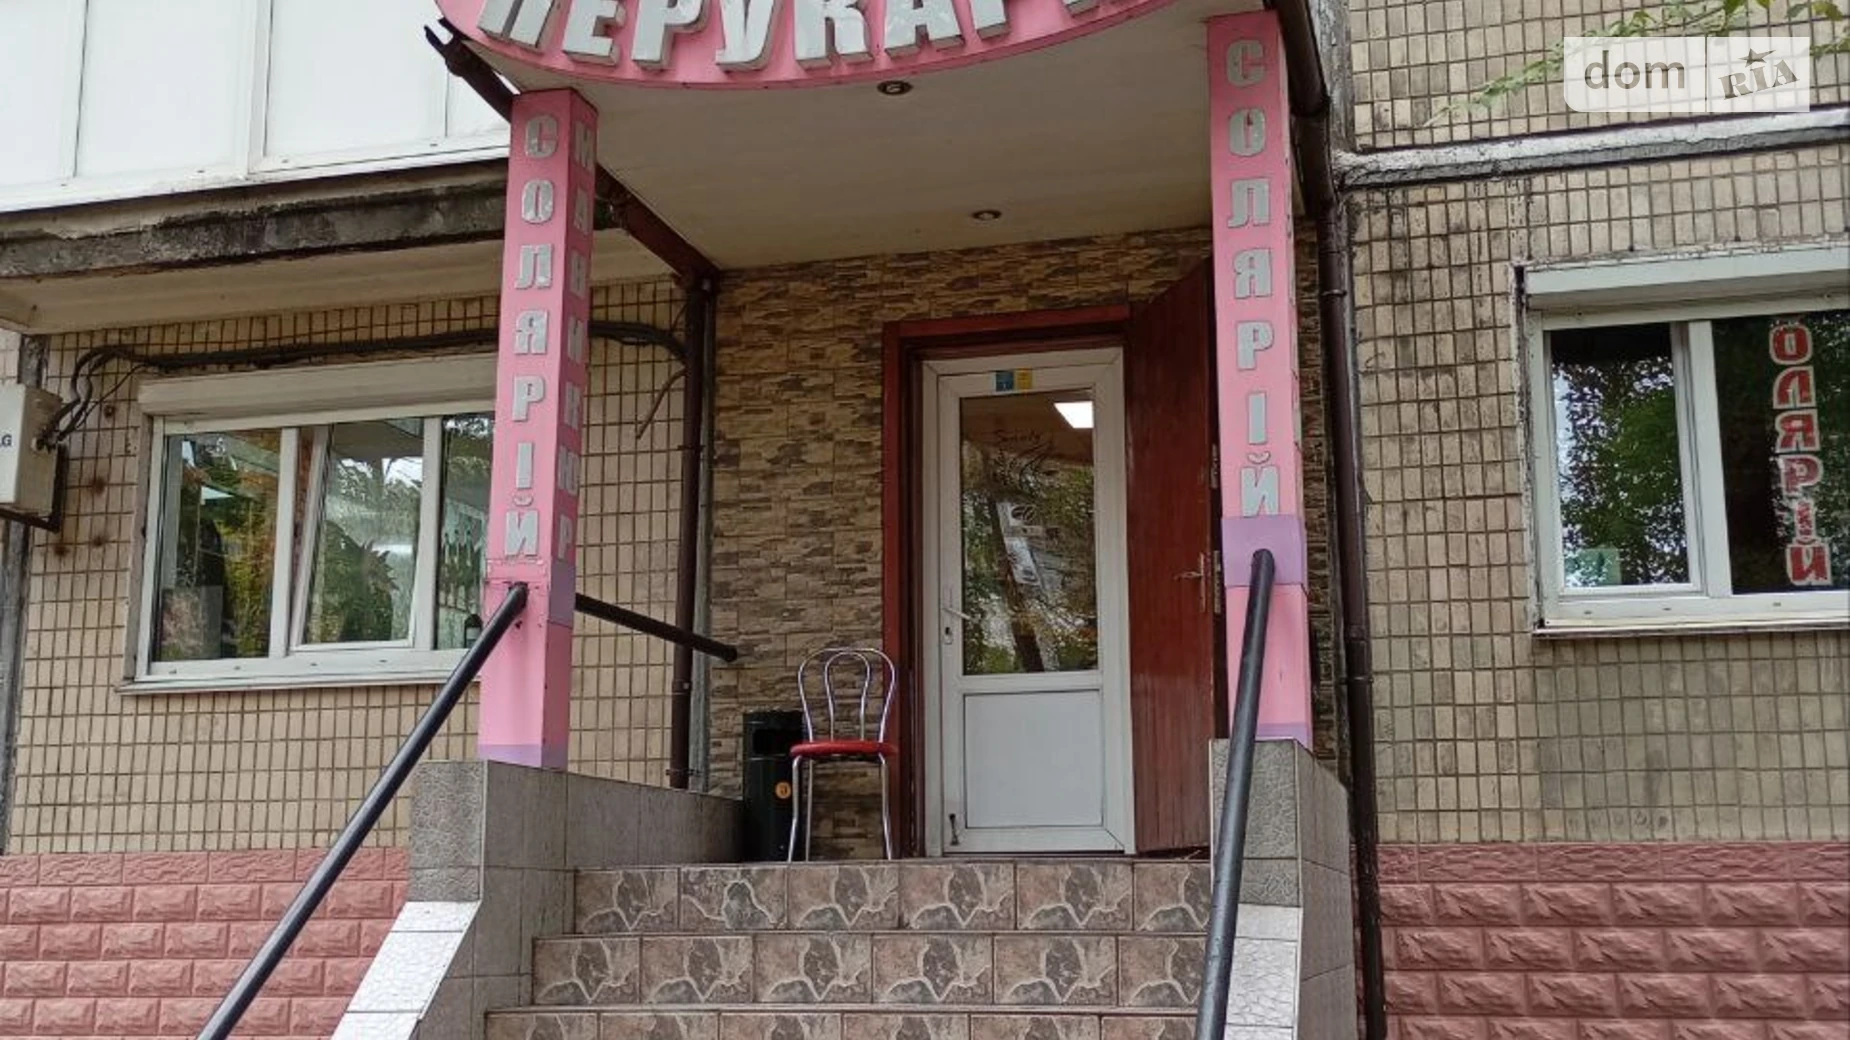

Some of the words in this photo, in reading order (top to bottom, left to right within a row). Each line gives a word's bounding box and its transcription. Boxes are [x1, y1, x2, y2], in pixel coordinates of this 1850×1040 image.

[504, 114, 560, 557] СОЛЯРІЙ
[1226, 38, 1281, 517] СОЛЯРІЙ
[1769, 316, 1832, 586] ОЛЯРІЙ
